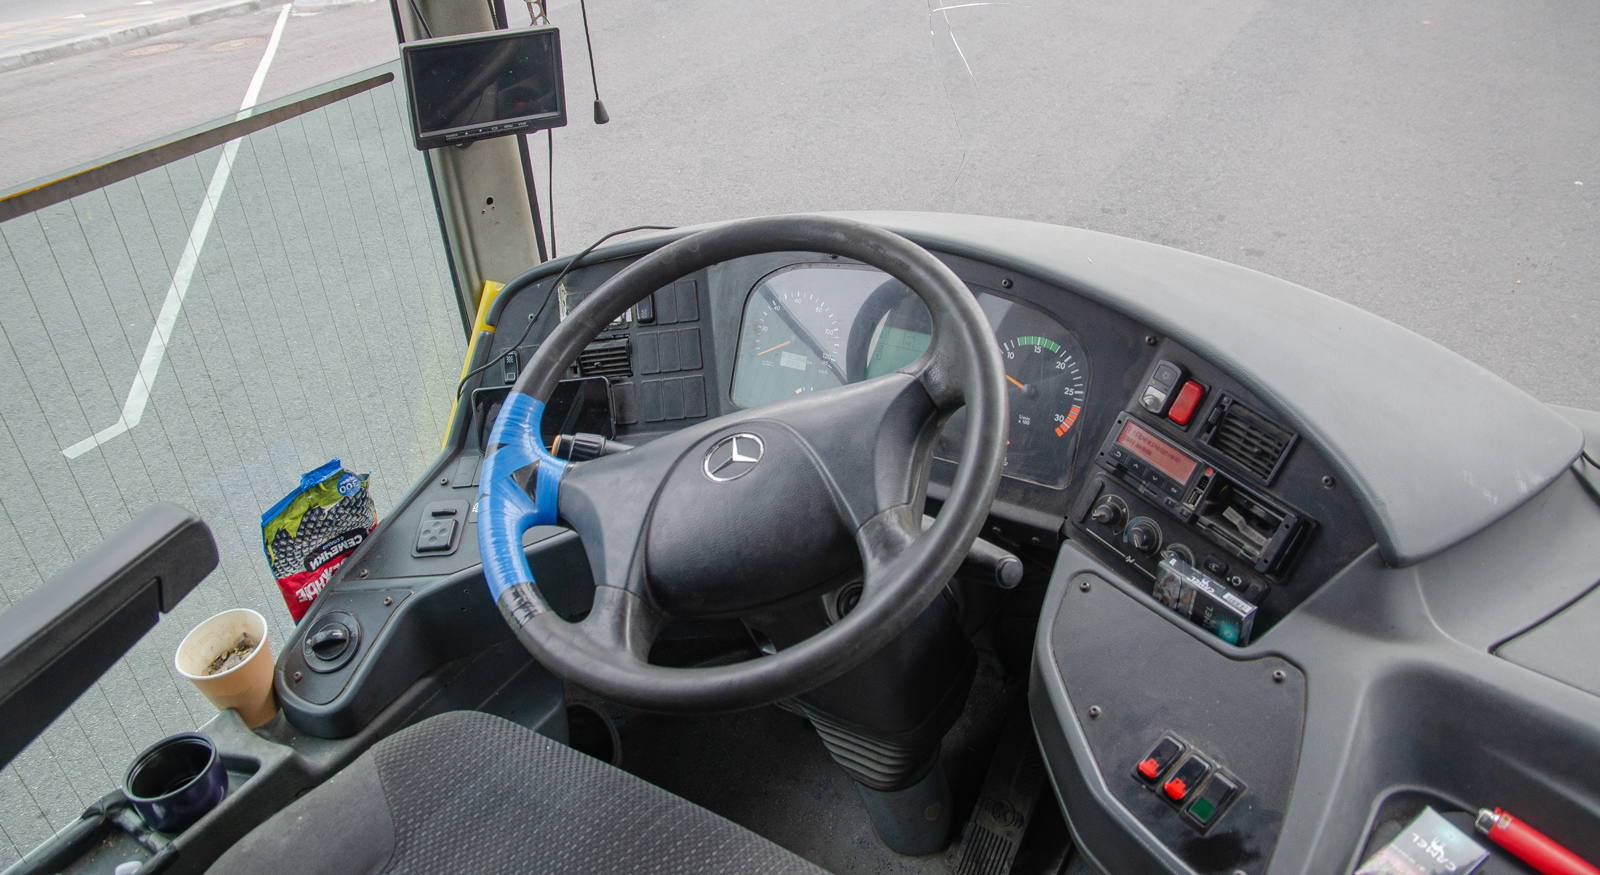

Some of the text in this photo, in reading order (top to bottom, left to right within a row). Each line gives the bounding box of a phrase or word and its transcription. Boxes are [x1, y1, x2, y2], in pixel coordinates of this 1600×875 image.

[824, 328, 834, 336] 100
[1034, 345, 1042, 353] 15
[822, 352, 832, 360] 120
[1007, 351, 1015, 359] 10
[1055, 361, 1066, 370] 20
[1064, 387, 1074, 396] 25
[1054, 414, 1064, 422] 30
[338, 478, 359, 494] 300
[309, 534, 363, 571] СЕМЕЧКИ
[1190, 575, 1215, 593] CAMEL
[1412, 833, 1457, 872] CAMEL
